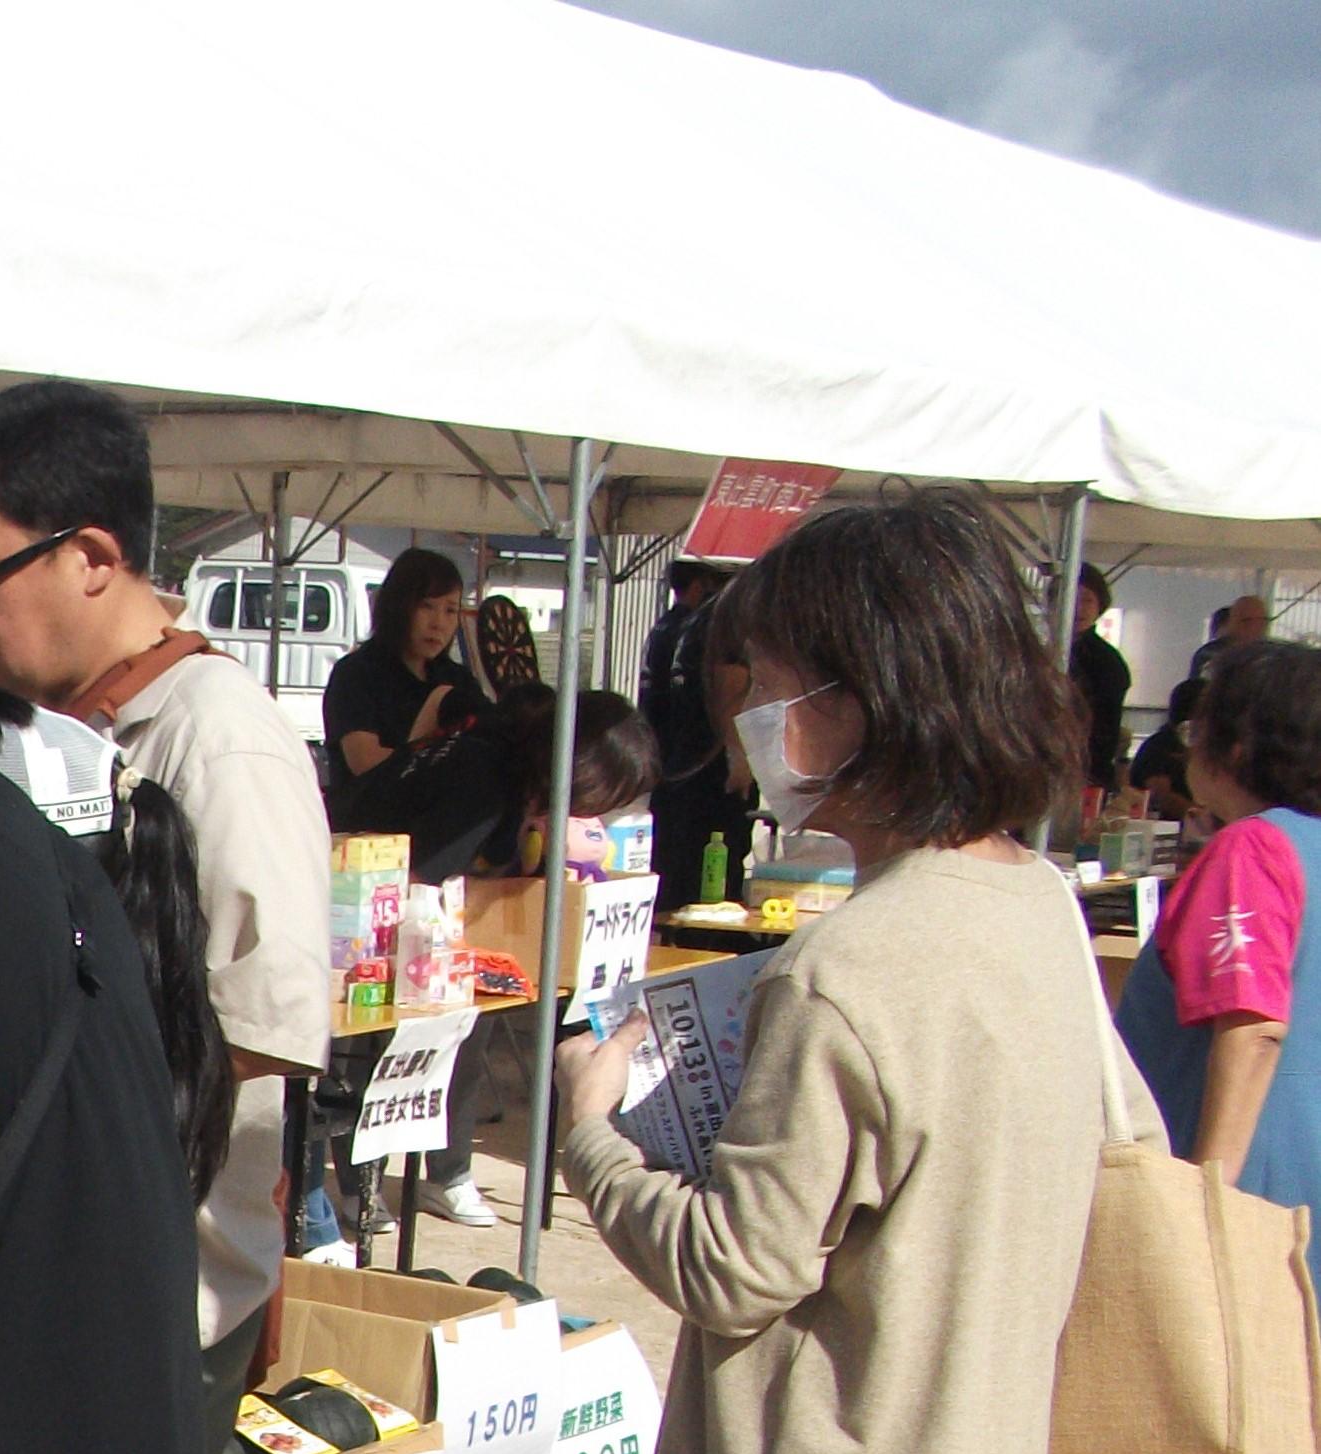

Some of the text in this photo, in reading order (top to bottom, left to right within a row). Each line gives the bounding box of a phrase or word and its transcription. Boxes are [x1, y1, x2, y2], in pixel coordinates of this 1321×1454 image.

[585, 895, 655, 942] フードドライブ
[466, 1392, 538, 1448] 150円
[559, 1391, 624, 1438] 新鮮野菜
